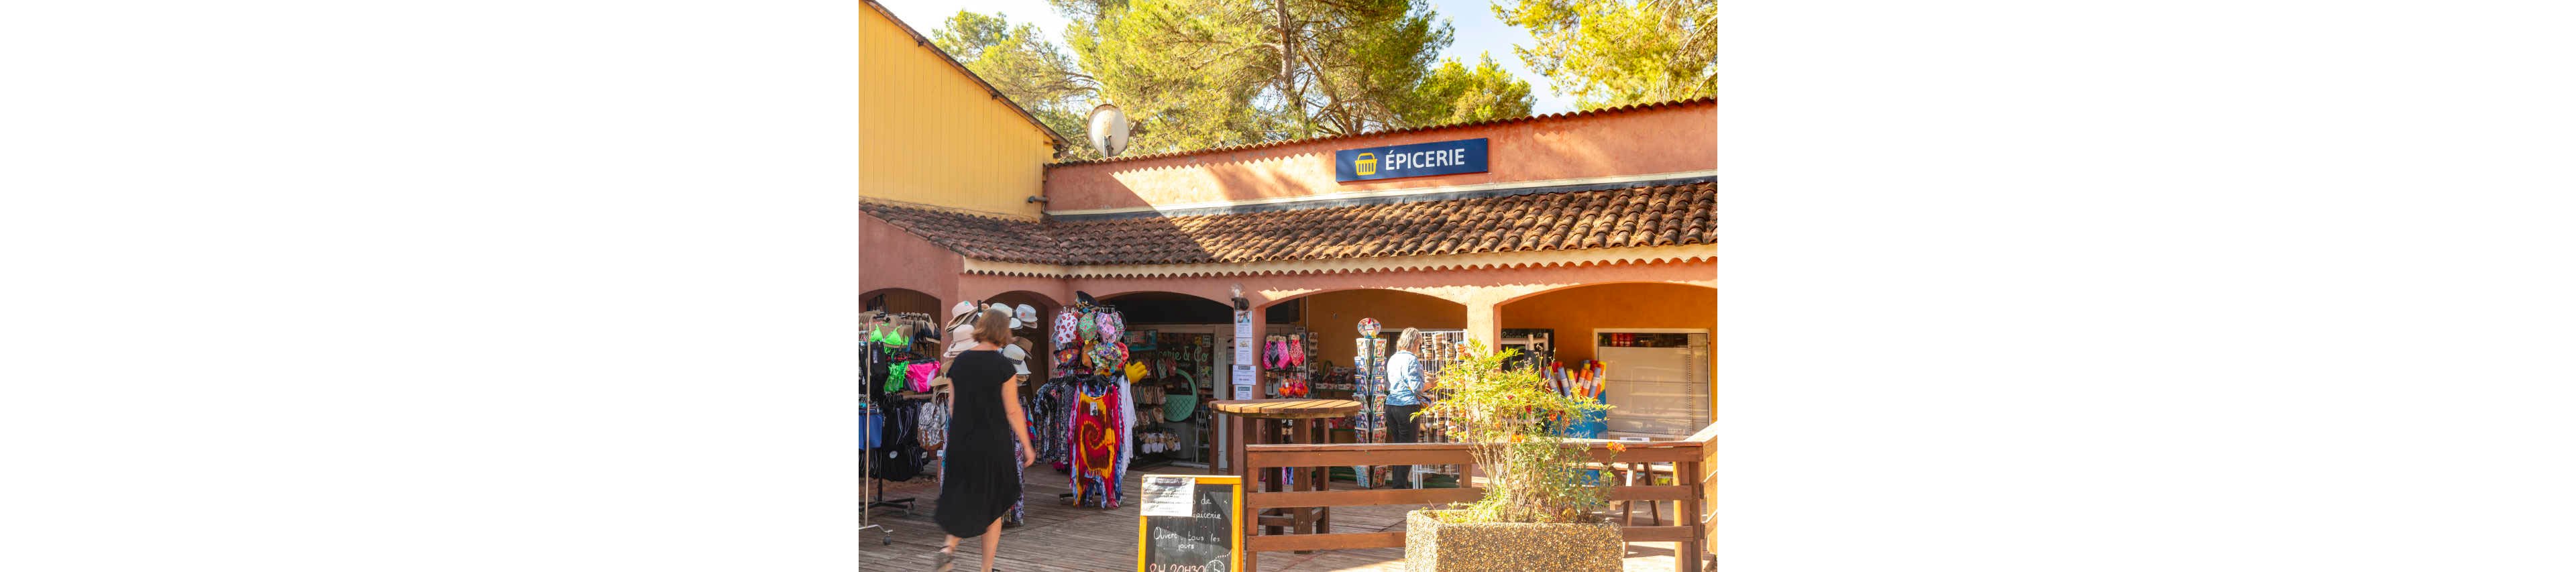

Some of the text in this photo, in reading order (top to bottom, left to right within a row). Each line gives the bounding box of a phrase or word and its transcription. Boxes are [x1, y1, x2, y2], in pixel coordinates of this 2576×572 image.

[1385, 149, 1465, 170] ÉPICERIE
[1201, 493, 1212, 504] de
[1154, 526, 1220, 542] Ouvert tous les
